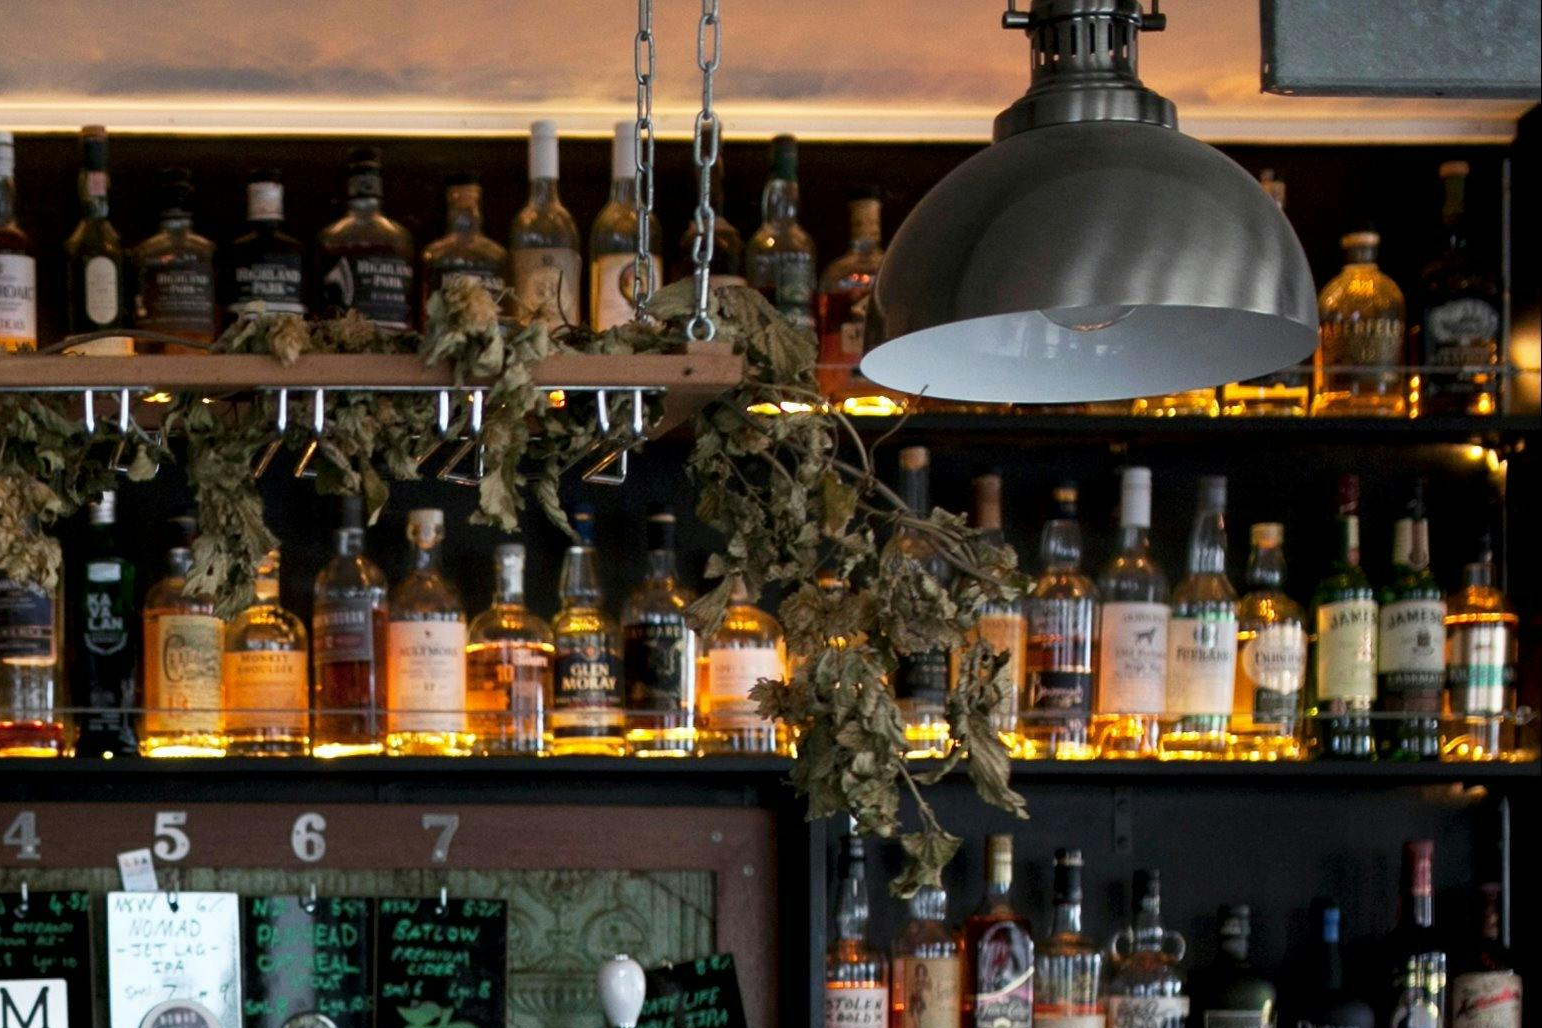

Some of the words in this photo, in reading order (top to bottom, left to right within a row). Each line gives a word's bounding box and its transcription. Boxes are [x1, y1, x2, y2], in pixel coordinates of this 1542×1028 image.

[570, 662, 610, 677] GLEN
[561, 676, 617, 692] MORAY
[3, 811, 42, 861] 4
[154, 811, 190, 862] 5
[291, 813, 326, 863] 6
[422, 813, 459, 863] 7
[129, 918, 203, 937] NOMAD
[392, 918, 481, 943] BATLOW
[131, 943, 164, 958] JET
[391, 946, 471, 967] PREMIUM
[151, 960, 185, 975] IPA
[162, 984, 178, 1000] 7
